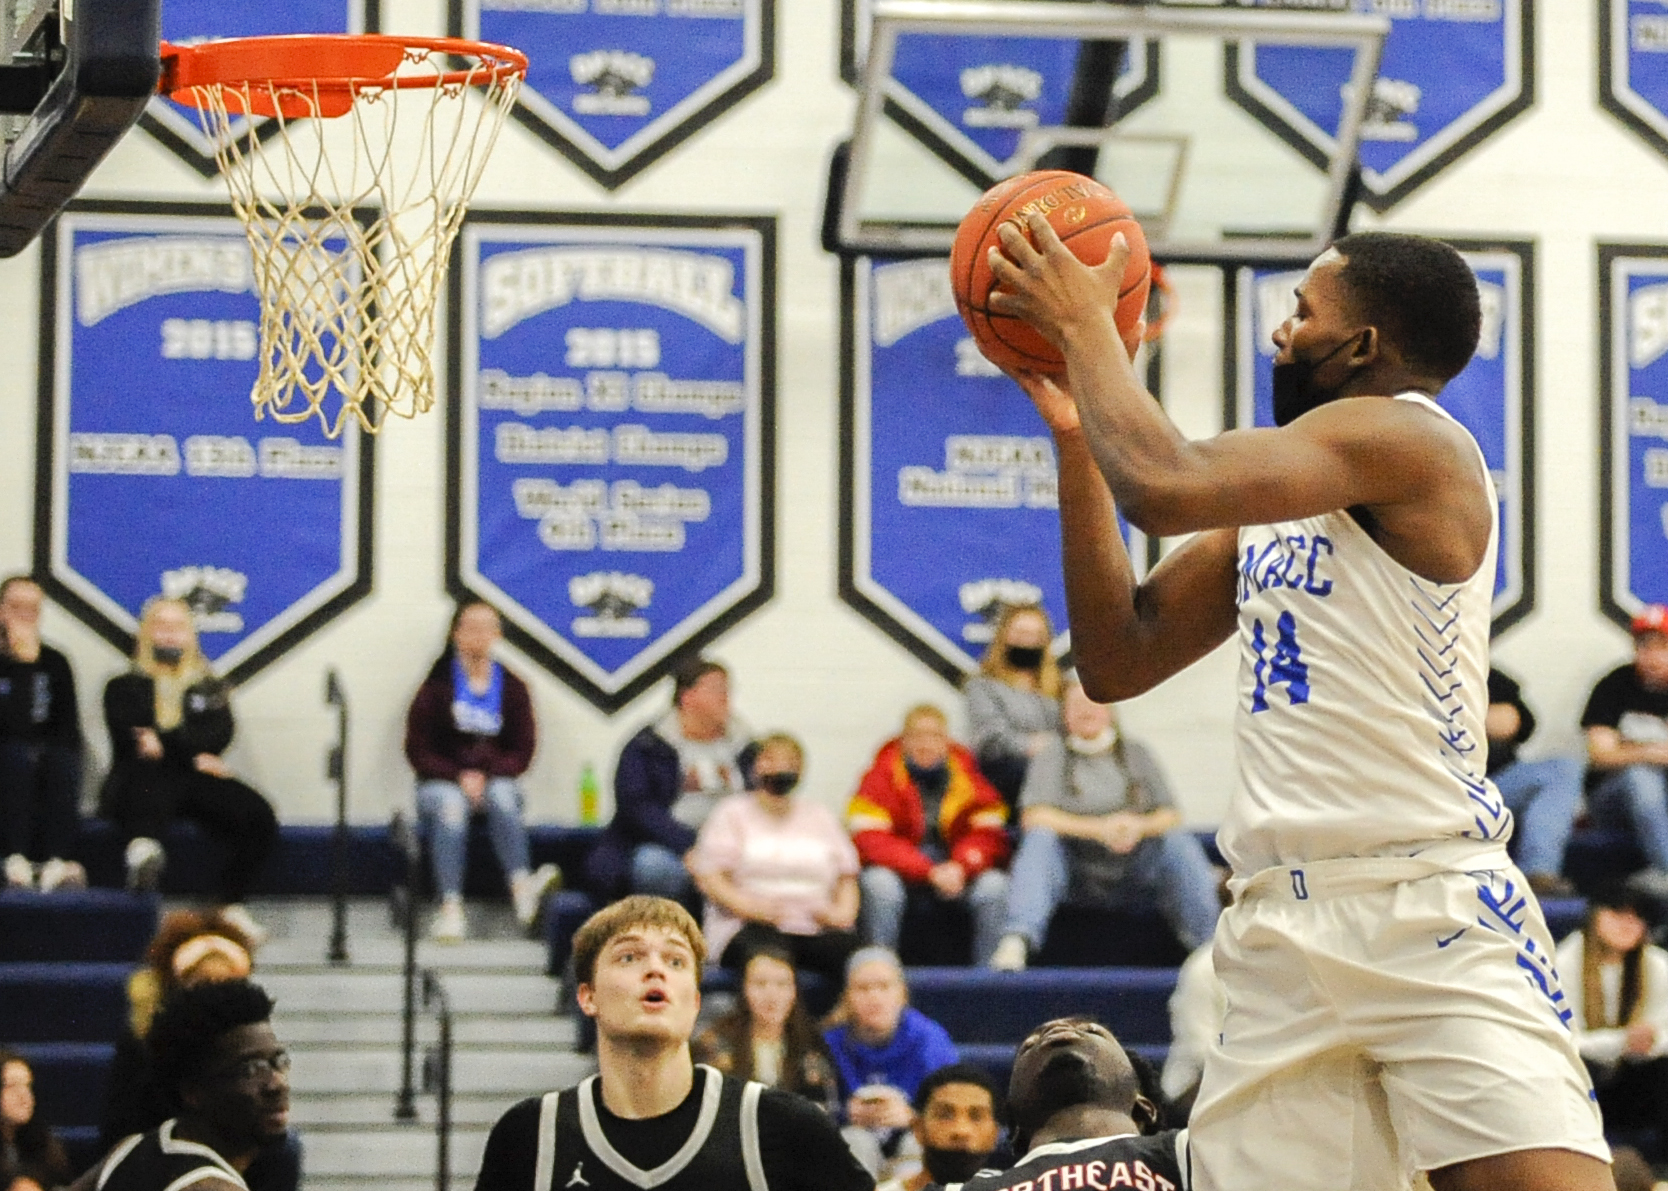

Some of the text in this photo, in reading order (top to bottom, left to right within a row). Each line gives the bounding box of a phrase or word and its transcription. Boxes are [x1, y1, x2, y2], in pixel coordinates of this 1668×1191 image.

[480, 245, 744, 345] SOFTBALL
[1236, 533, 1334, 604] MACC
[1251, 609, 1310, 714] 14
[1000, 1159, 1177, 1191] THEAST
